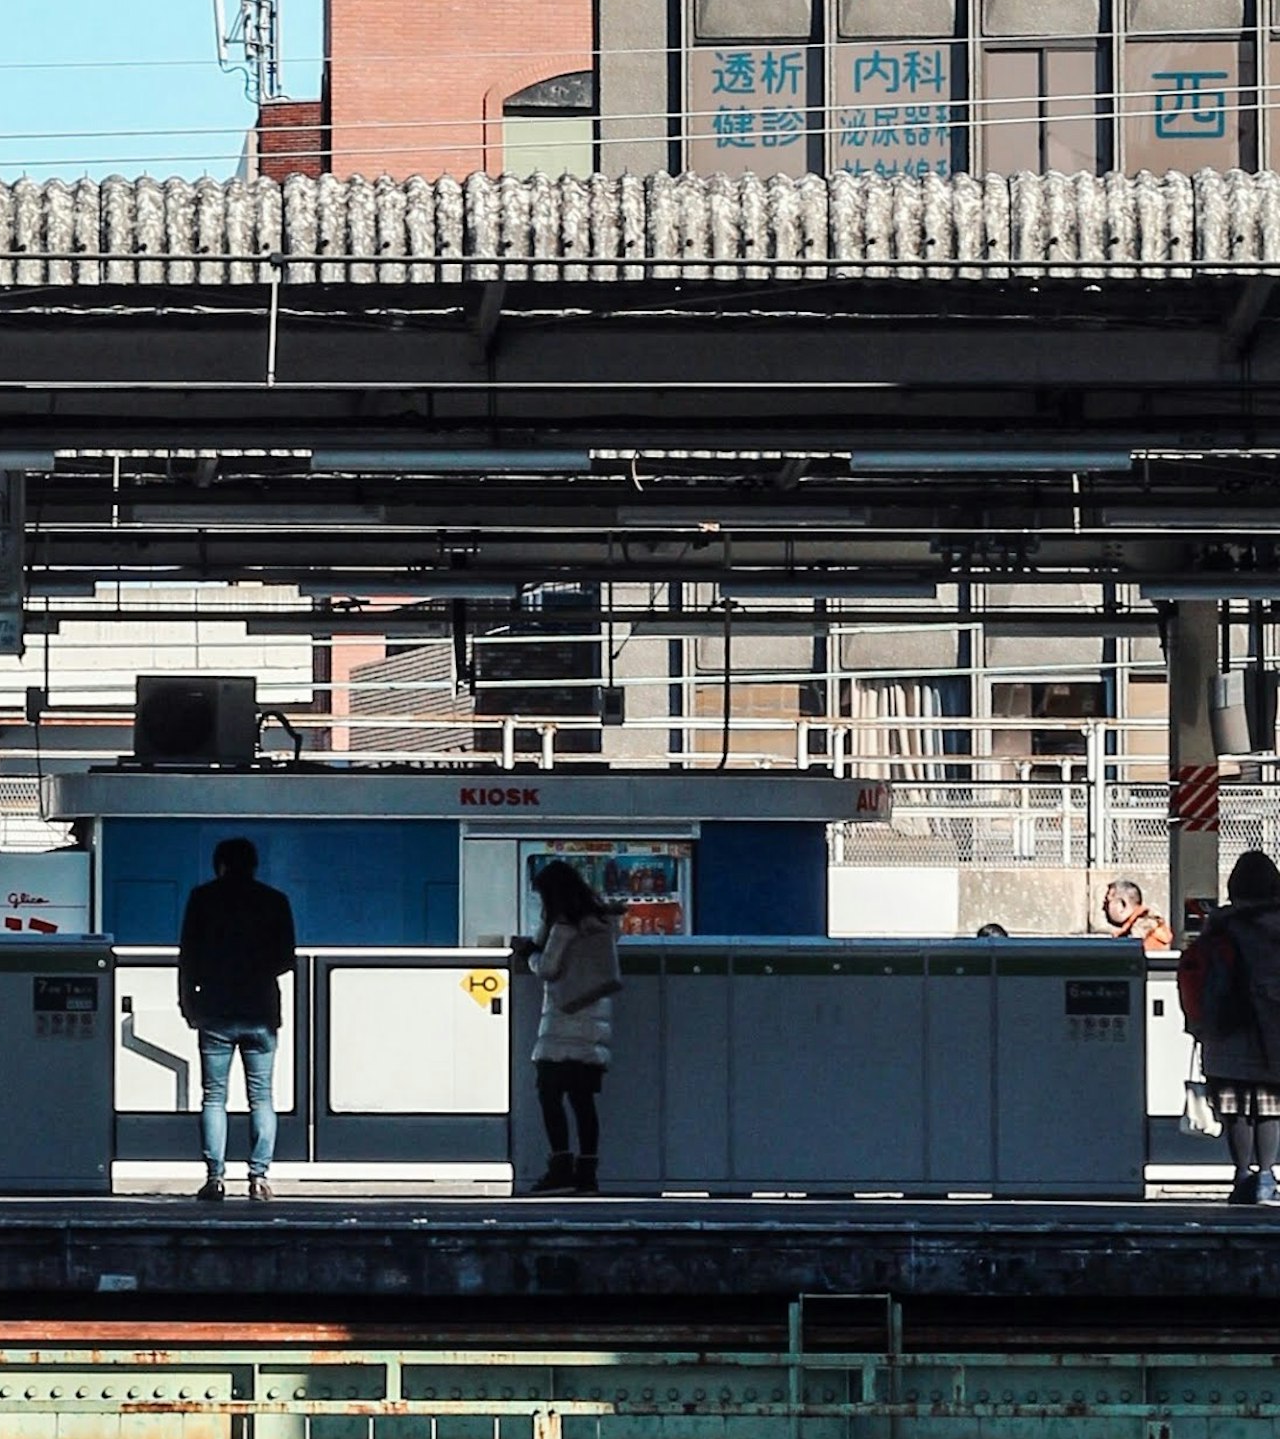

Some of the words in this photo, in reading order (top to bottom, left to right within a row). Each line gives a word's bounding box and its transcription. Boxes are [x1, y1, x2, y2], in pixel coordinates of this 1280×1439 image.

[712, 51, 804, 95] 透析
[853, 49, 946, 94] 内科
[712, 104, 805, 149] 健診
[1151, 71, 1228, 139] 西
[460, 788, 540, 806] KIOSK
[8, 892, 50, 908] Glico
